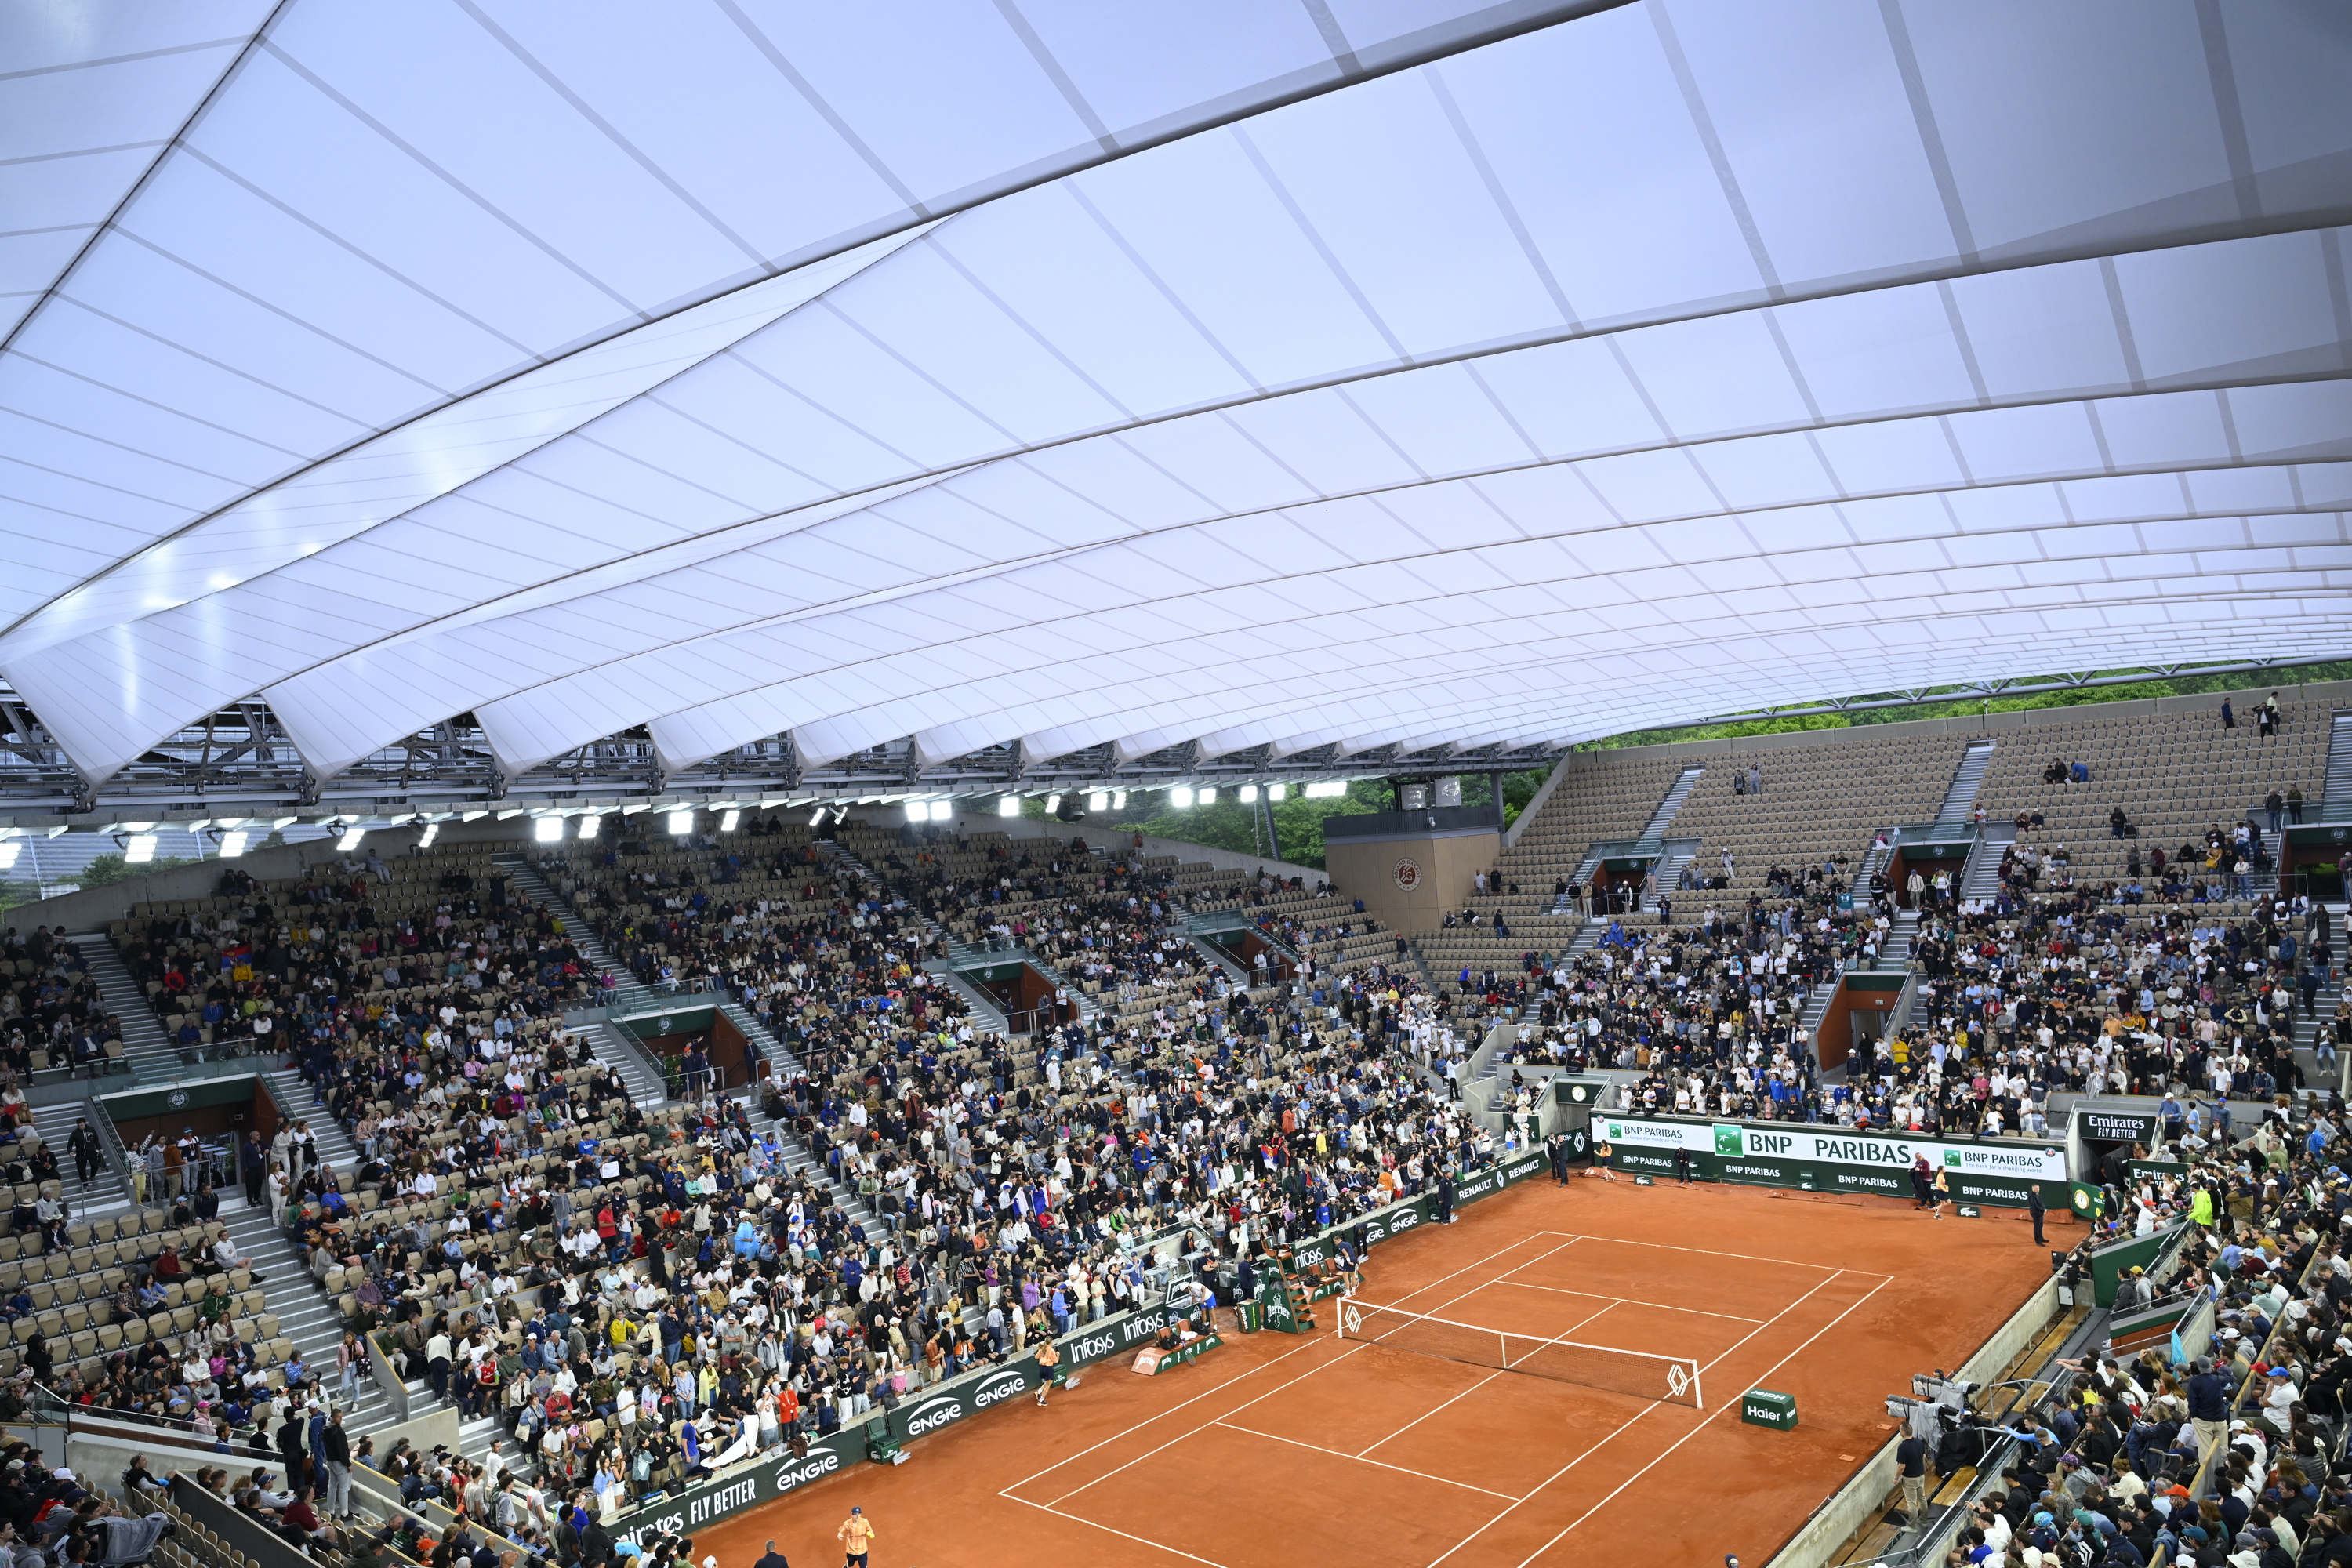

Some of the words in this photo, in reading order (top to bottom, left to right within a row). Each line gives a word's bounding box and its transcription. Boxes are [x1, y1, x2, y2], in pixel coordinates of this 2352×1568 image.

[1394, 860, 1406, 879] ROLAND
[1406, 860, 1421, 877] GARROS
[2089, 1115, 2145, 1129] Emirates
[1624, 1126, 1642, 1135] BNP
[1645, 1127, 1682, 1138] PARIBAS
[2098, 1127, 2109, 1137] FLY
[2111, 1129, 2137, 1138] BETTER
[1749, 1134, 1792, 1154] BNP
[1814, 1138, 1911, 1164] PARIBAS
[1640, 1157, 1672, 1167] PARIBAS
[1965, 1152, 1988, 1163] BNP
[1991, 1154, 2042, 1167] PARIBAS
[1508, 1159, 1540, 1179] RENAULT
[1726, 1165, 1744, 1174] BNP
[1744, 1167, 1780, 1178] PARIBAS
[1459, 1178, 1492, 1200] RENAULT
[1838, 1175, 1857, 1184] BNP
[1859, 1177, 1898, 1189] PARIBAS
[1962, 1186, 1984, 1196] BNP
[1985, 1189, 2028, 1200] PARIBAS
[1295, 1247, 1323, 1269] nfosys
[1123, 1312, 1164, 1341] Infosys
[1070, 1332, 1115, 1363] Infosys
[1751, 1390, 1786, 1400] Haier
[1748, 1405, 1780, 1421] Haier
[690, 1495, 710, 1525] FLY
[713, 1478, 756, 1515] BETTER
